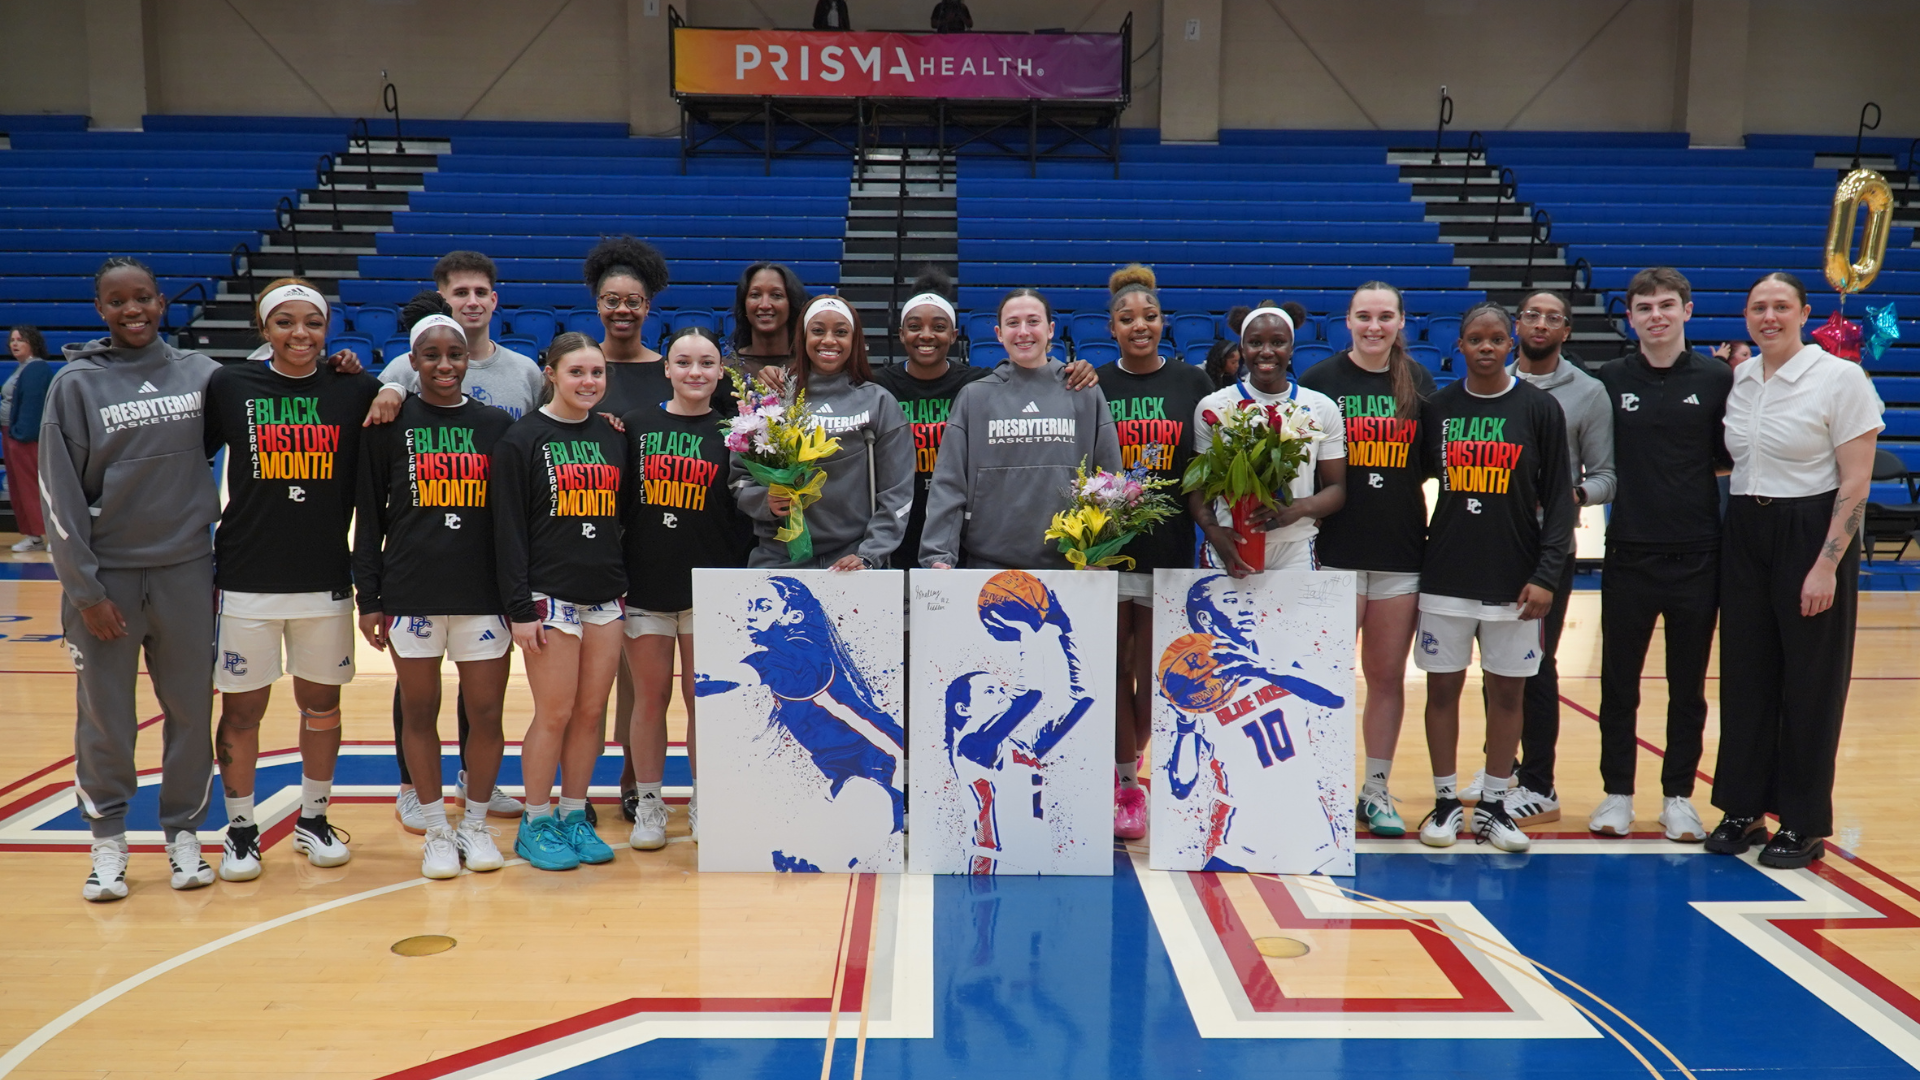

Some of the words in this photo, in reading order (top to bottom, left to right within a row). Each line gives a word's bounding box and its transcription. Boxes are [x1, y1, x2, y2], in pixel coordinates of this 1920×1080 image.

[735, 44, 915, 82] PRISMA
[100, 391, 202, 427] PRESBYTERIAN
[105, 411, 202, 434] BASKETBALL
[255, 397, 321, 424] BLACK
[1110, 396, 1167, 422] BLACK
[257, 424, 340, 452] HISTORY
[414, 427, 477, 453] BLACK
[988, 418, 1076, 437] PRESBYTERIAN
[988, 436, 1076, 445] BASKETBALL
[1346, 416, 1417, 444] HISTORY
[1448, 417, 1506, 442] BLACK
[550, 441, 607, 465] BLACK
[645, 431, 703, 459] BLACK
[1347, 441, 1410, 468] MONTH
[1447, 440, 1523, 470] HISTORY
[259, 451, 333, 479] MONTH
[554, 463, 619, 492] HISTORY
[644, 454, 719, 487] HISTORY
[417, 479, 487, 507] MONTH
[1447, 465, 1511, 494] MONTH
[557, 489, 616, 516] MONTH
[644, 479, 707, 511] MONTH
[1214, 695, 1257, 726] BLUE
[1241, 708, 1296, 769] 10
